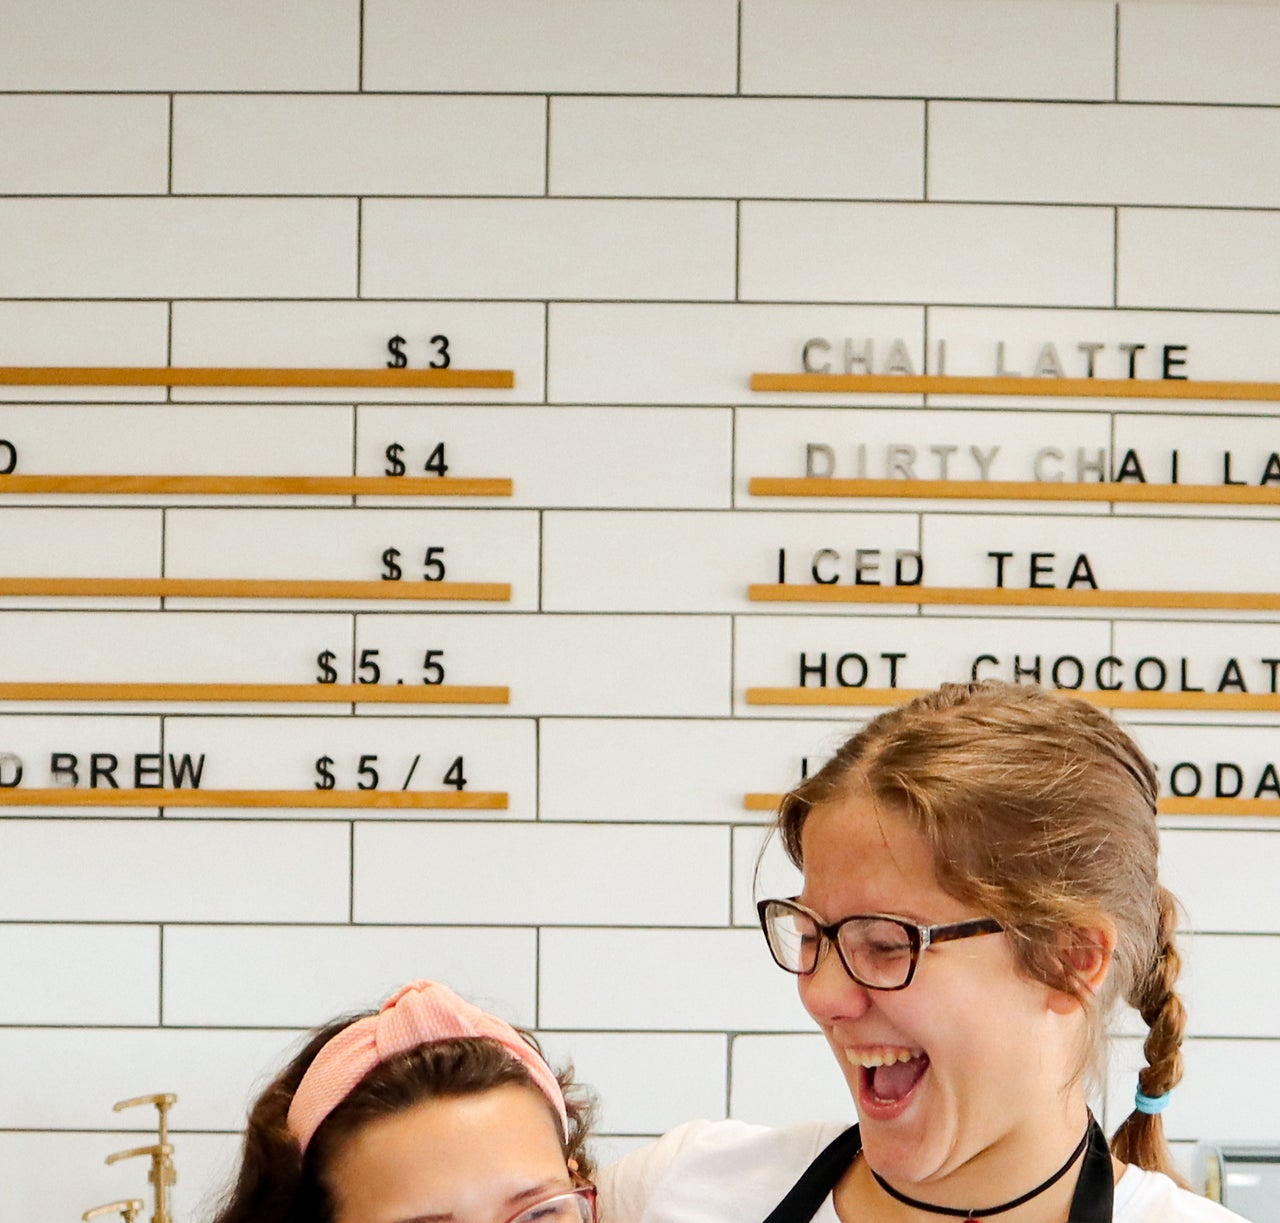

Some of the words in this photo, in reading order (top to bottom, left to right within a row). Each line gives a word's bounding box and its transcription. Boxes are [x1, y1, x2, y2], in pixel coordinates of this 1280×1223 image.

[802, 337, 947, 377] CHAI
[995, 341, 1189, 381] LATTE
[805, 442, 1000, 482] DIRTY
[1034, 446, 1180, 485] CHAI
[778, 547, 924, 587] ICED
[987, 551, 1099, 591] TEA
[799, 651, 907, 688] HOT
[50, 752, 205, 790] BREW
